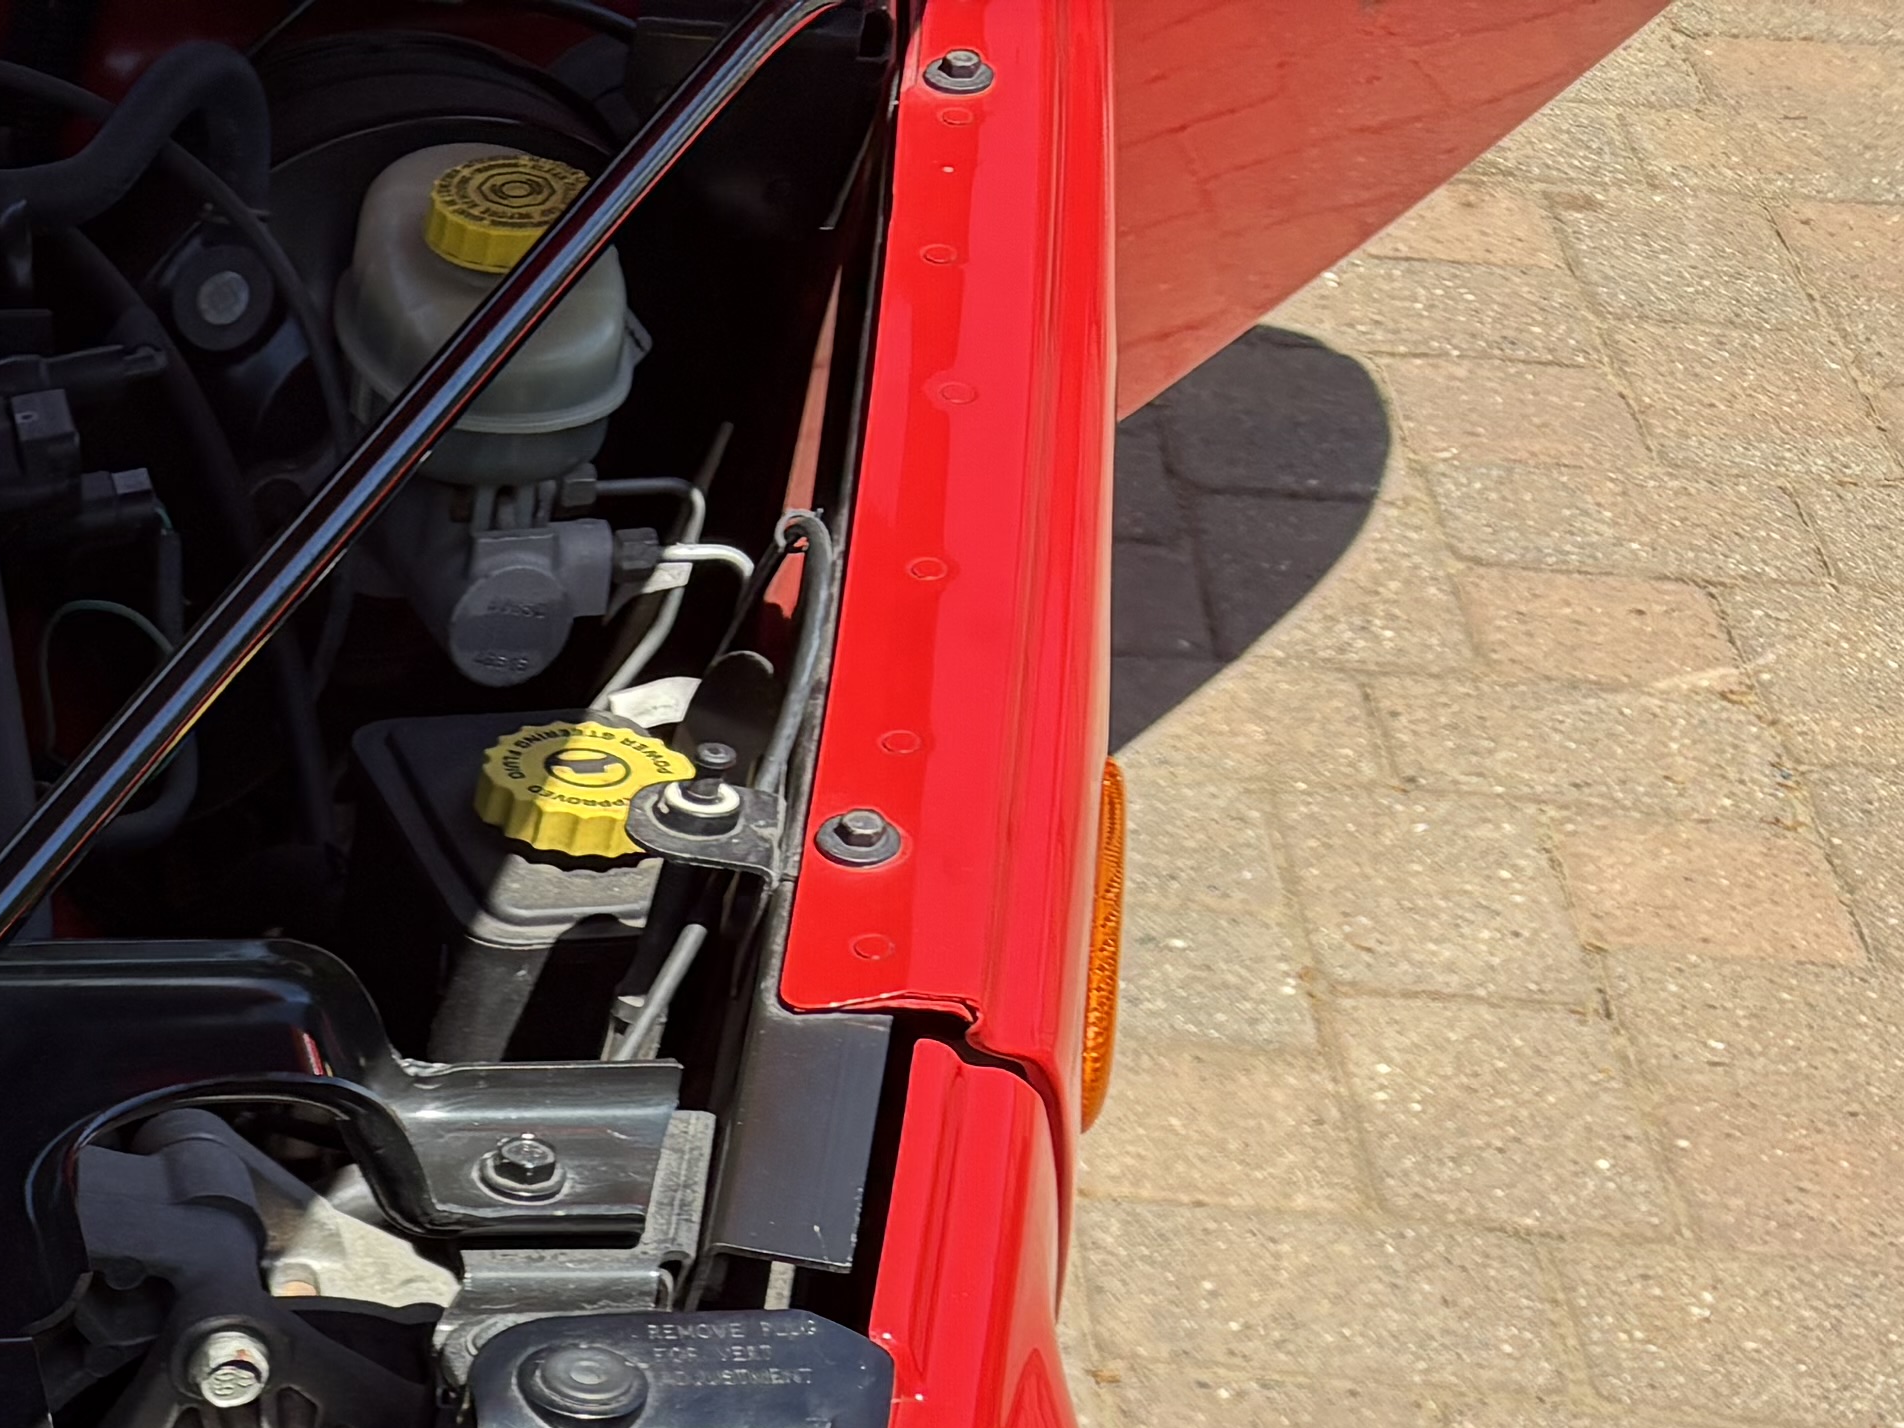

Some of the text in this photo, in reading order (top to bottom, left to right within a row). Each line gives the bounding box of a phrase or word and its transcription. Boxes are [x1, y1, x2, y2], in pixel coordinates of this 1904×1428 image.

[502, 727, 673, 780] POWER STEERING FLUID
